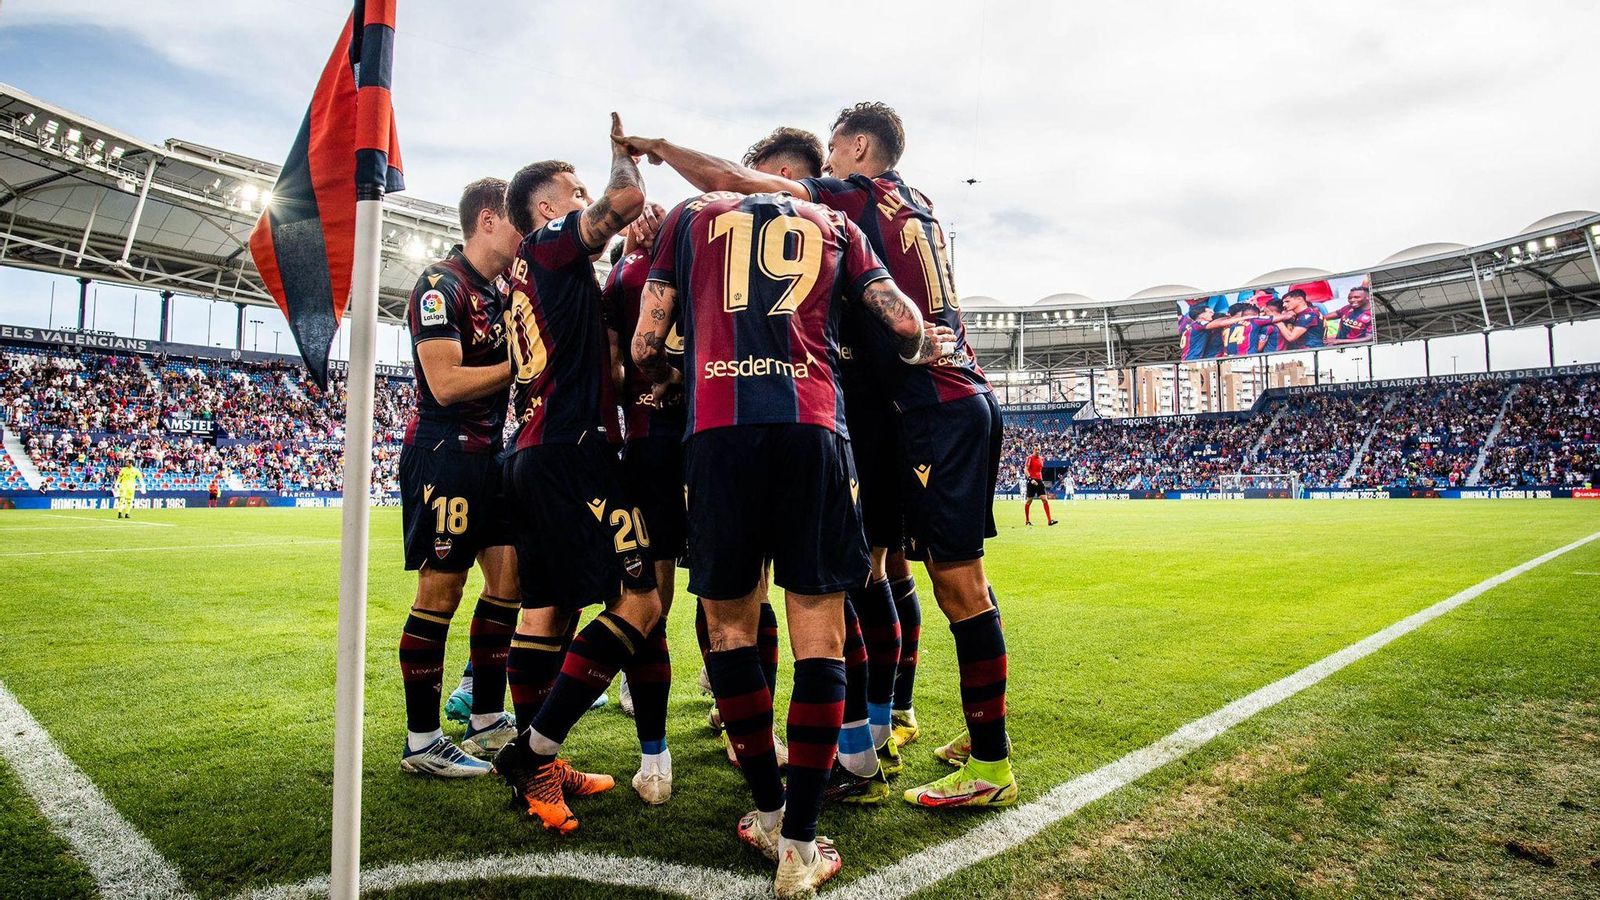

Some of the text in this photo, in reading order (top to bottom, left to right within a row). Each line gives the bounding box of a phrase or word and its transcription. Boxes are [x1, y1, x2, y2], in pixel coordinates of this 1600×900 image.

[708, 210, 823, 317] 19
[1, 326, 147, 351] ELS VALENCIANS
[1222, 326, 1245, 347] 14
[704, 355, 809, 379] sesderma
[1340, 382, 1354, 391] EN
[1358, 379, 1379, 390] LAS
[1381, 376, 1427, 388] BARRAS
[1430, 370, 1512, 385] AZULGRANAS
[1516, 369, 1532, 379] DE
[1537, 367, 1553, 377] TU
[1000, 404, 1022, 412] ANDE
[1032, 403, 1047, 411] SER
[50, 498, 99, 510] HOMENAJE
[100, 498, 110, 510] AL
[152, 498, 164, 510] DE
[166, 498, 186, 510] 1963
[1536, 490, 1552, 498] 1963
[431, 496, 468, 534] 18
[609, 507, 649, 553] 20
